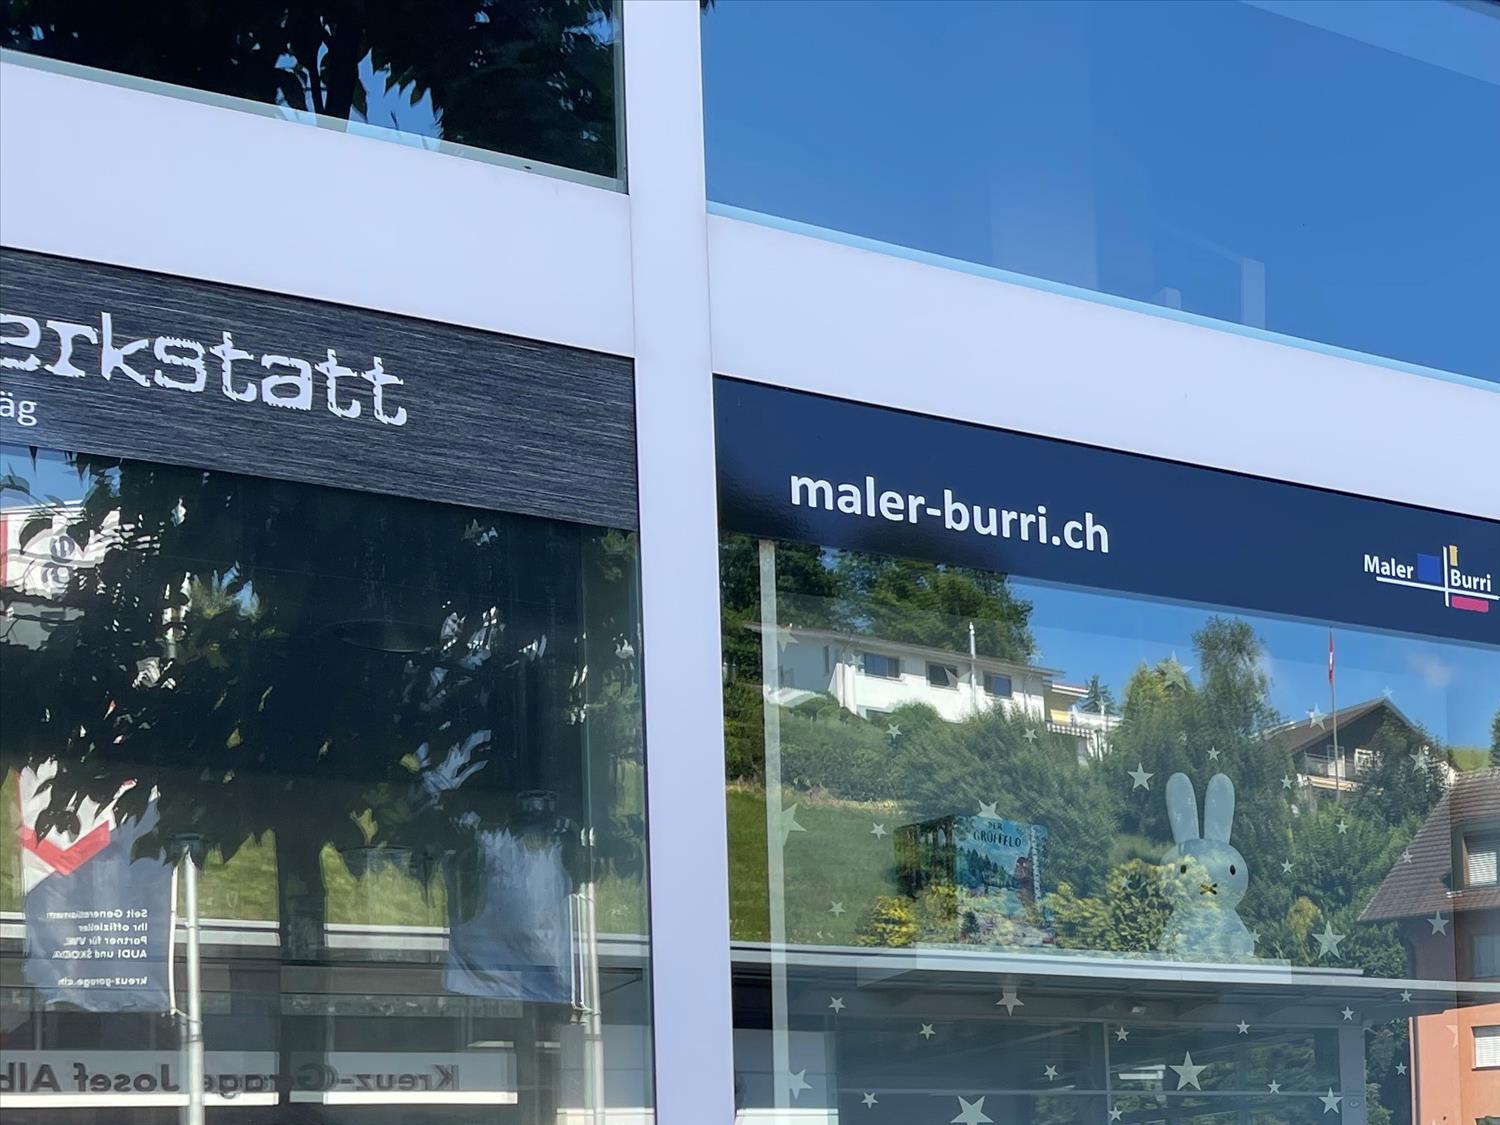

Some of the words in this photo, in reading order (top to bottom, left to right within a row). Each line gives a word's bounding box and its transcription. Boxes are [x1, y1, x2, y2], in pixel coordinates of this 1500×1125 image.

[791, 475, 1109, 554] maler-burri.ch
[1364, 554, 1414, 579] Maler
[1450, 569, 1491, 592] Burri
